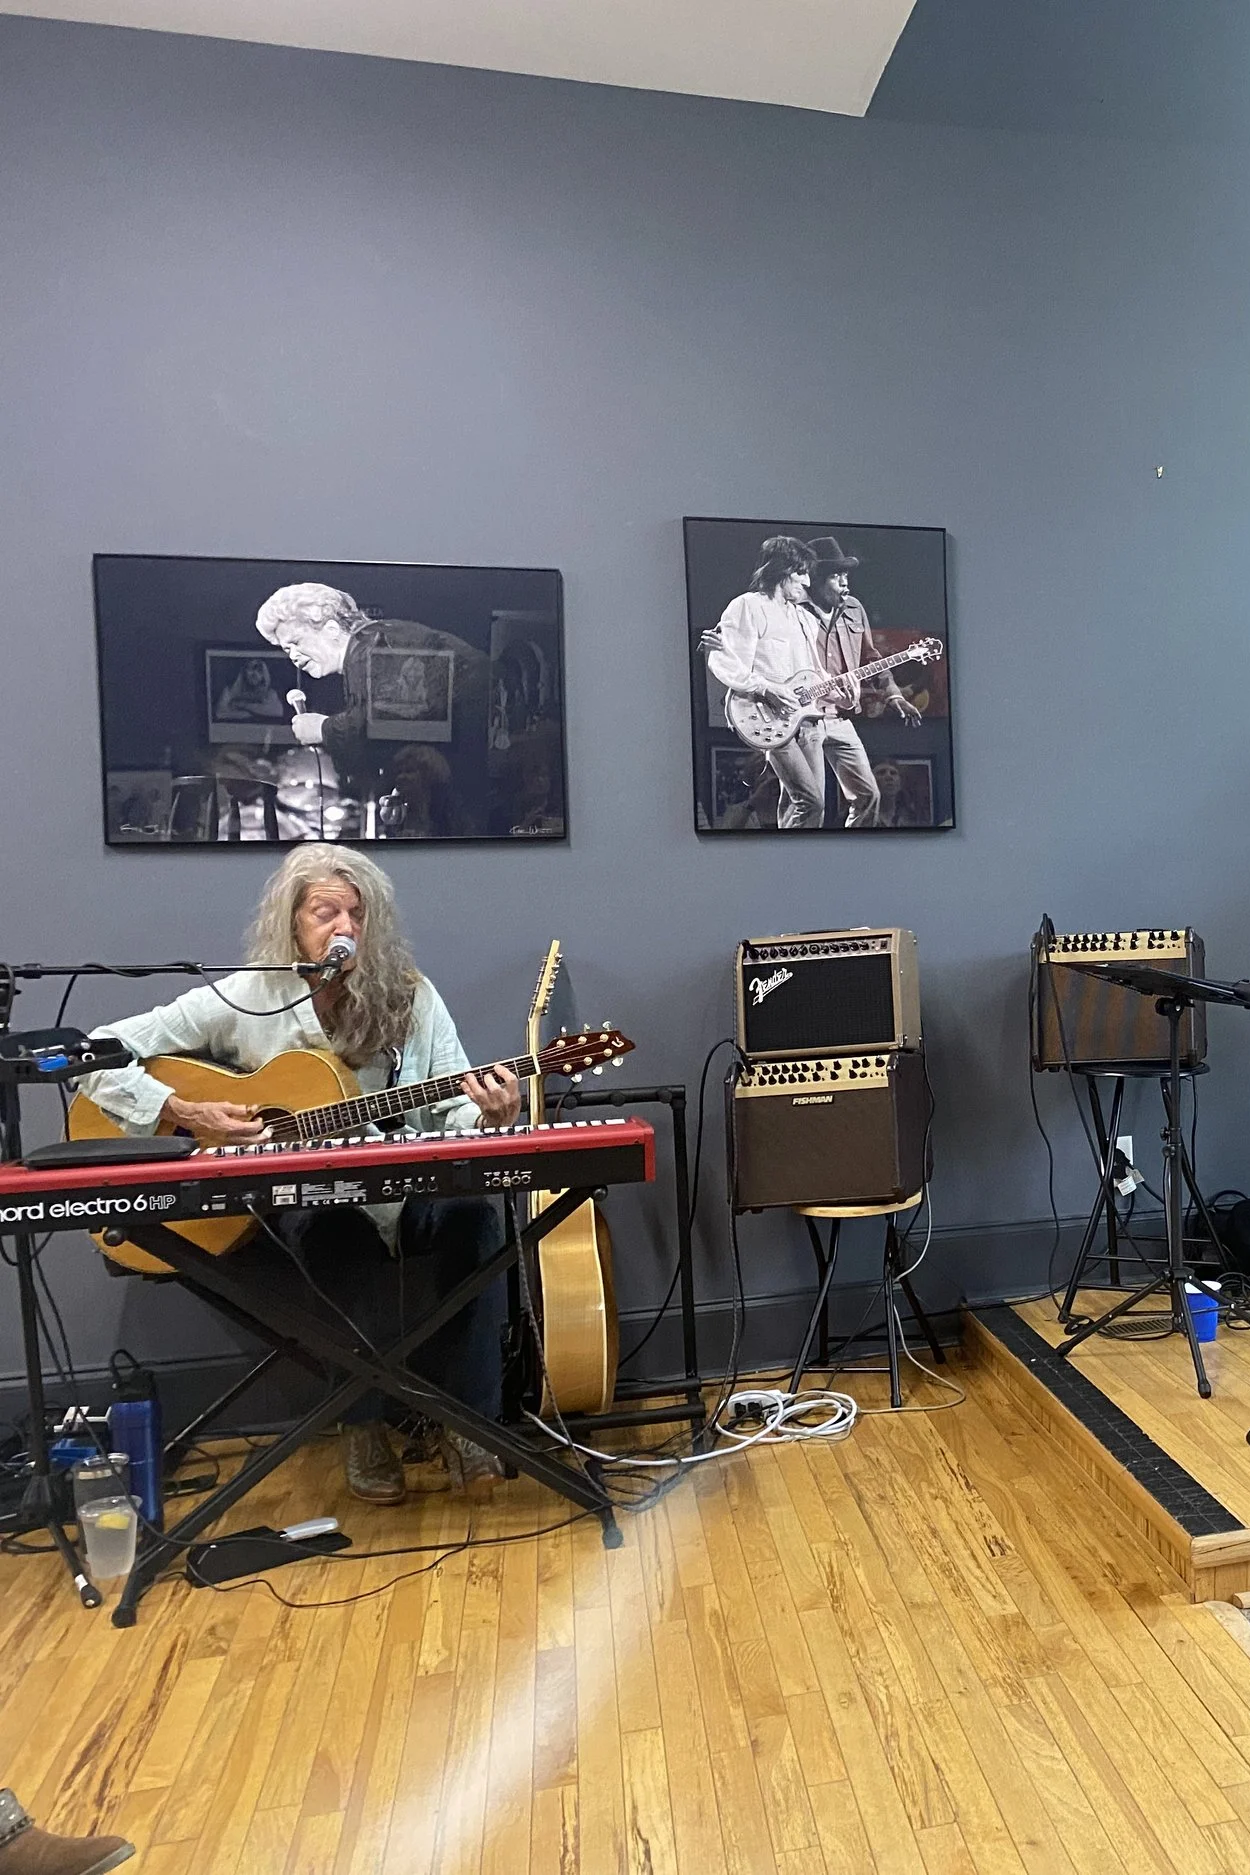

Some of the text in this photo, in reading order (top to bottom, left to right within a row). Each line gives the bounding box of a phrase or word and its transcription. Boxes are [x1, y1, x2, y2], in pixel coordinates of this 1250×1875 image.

[749, 967, 794, 1006] Fender
[792, 1095, 833, 1105] FISHMAN
[49, 1197, 131, 1218] electro
[133, 1194, 148, 1211] 6
[149, 1194, 176, 1210] HP
